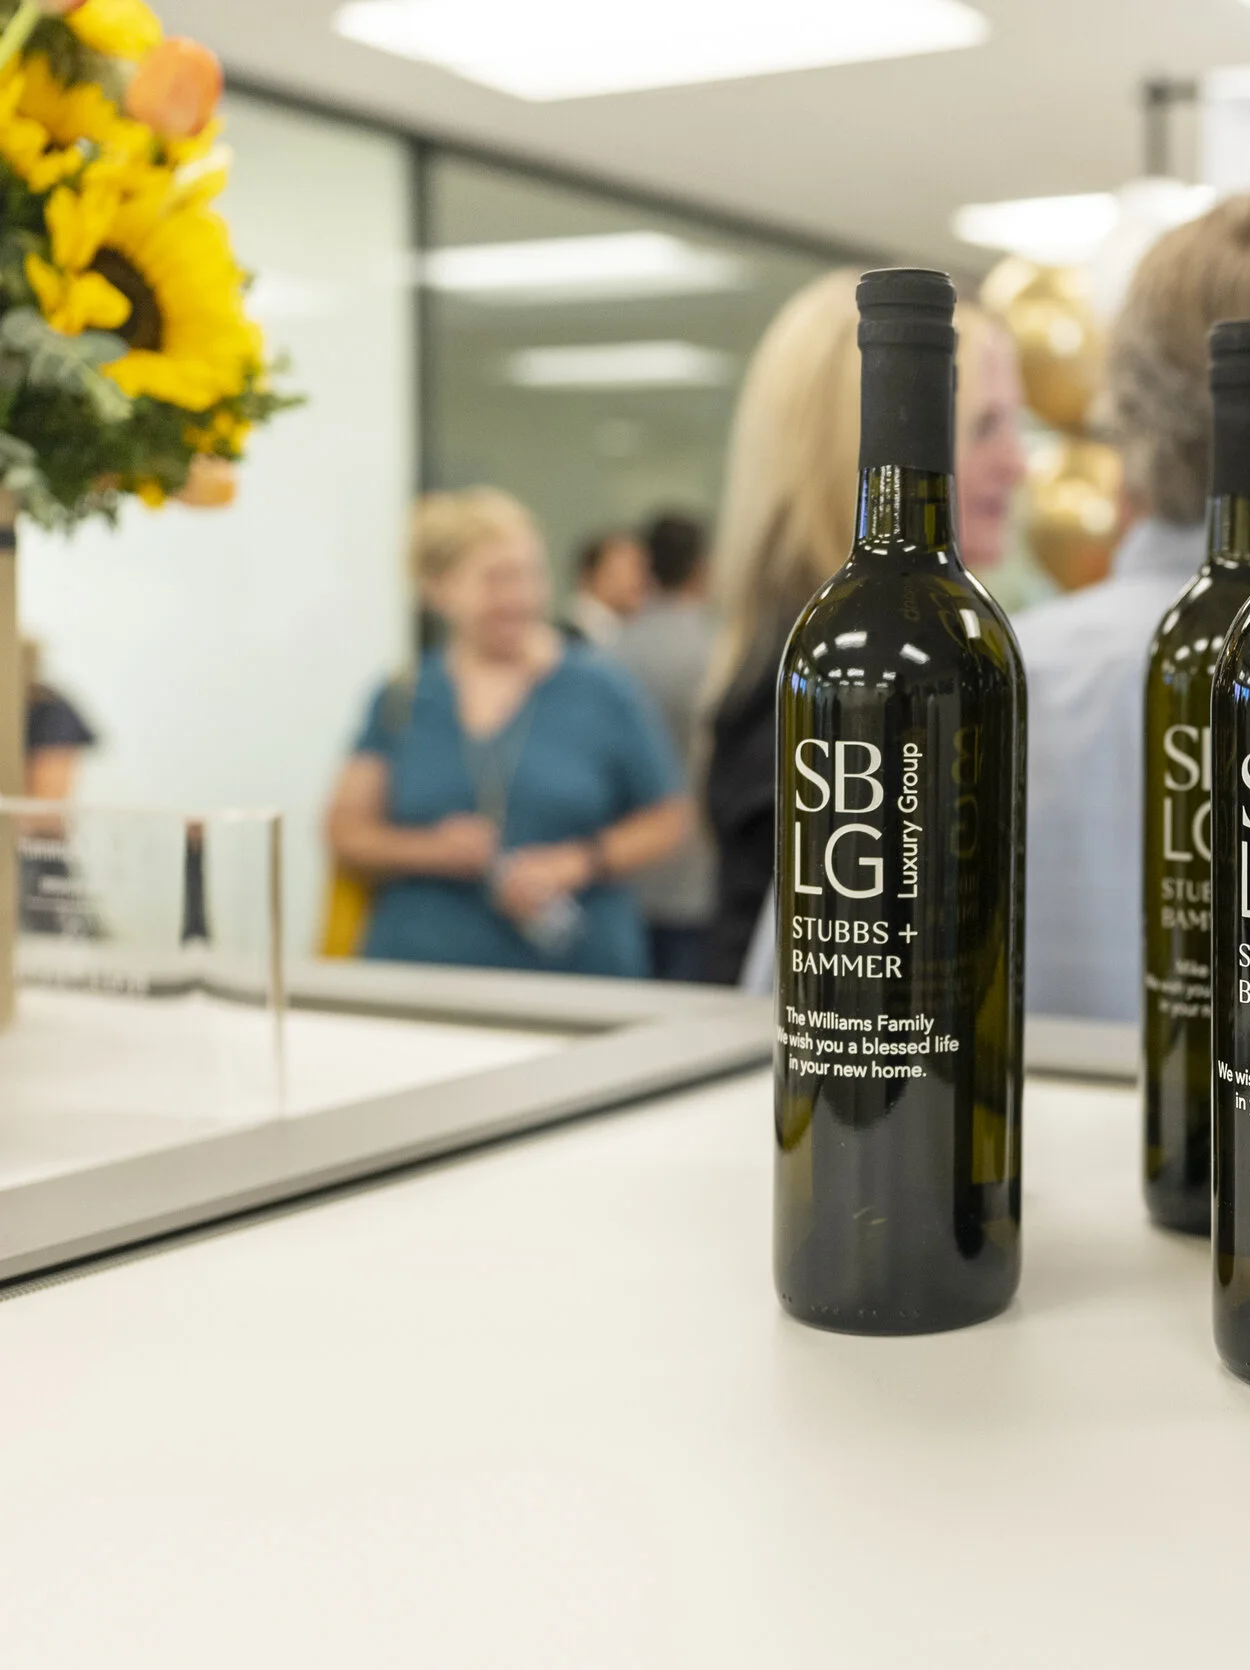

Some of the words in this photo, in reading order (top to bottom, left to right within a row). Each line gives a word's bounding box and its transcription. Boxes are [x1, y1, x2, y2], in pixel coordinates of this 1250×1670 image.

[1163, 724, 1211, 791] S
[795, 738, 884, 814] SB
[897, 742, 923, 814] Group
[794, 821, 884, 899] LG
[897, 820, 923, 899] Luxury
[792, 916, 889, 944] STUBBS
[792, 949, 902, 978] BAMMER
[786, 1006, 805, 1027] The
[807, 1010, 872, 1032] Williams
[877, 1013, 934, 1035] Family
[789, 1031, 813, 1050] wish
[816, 1040, 843, 1056] you
[848, 1042, 857, 1054] a
[862, 1036, 930, 1055] blessed
[935, 1035, 960, 1053] life
[789, 1053, 798, 1070] in
[800, 1058, 830, 1076] your
[833, 1064, 867, 1078] new
[871, 1060, 927, 1078] home.
[1218, 1060, 1233, 1082] We
[1235, 1092, 1246, 1110] in
